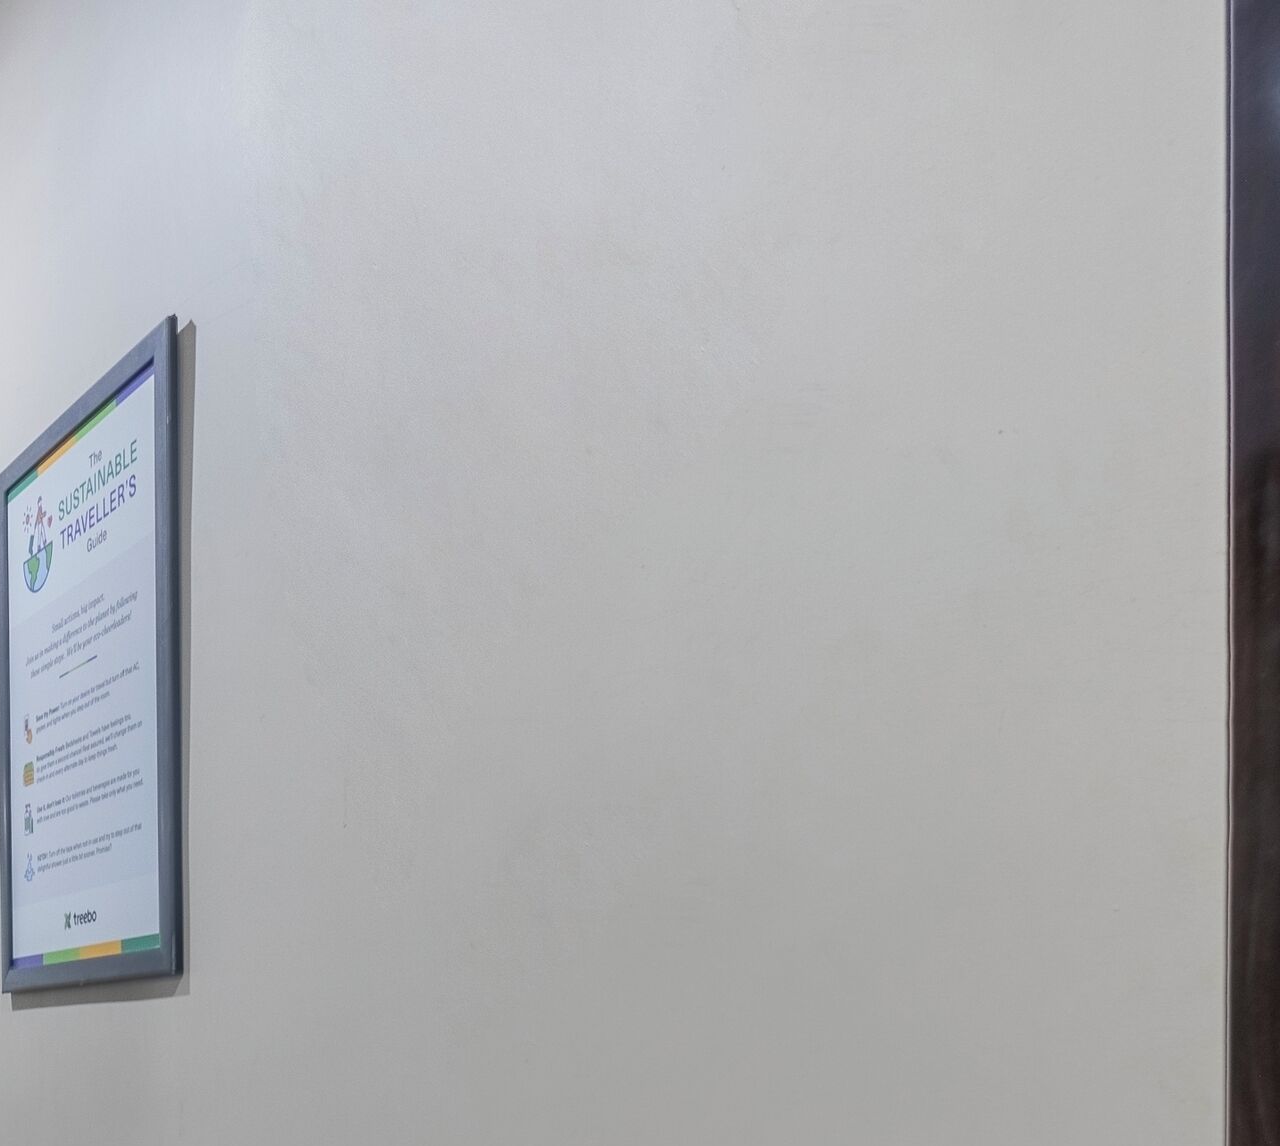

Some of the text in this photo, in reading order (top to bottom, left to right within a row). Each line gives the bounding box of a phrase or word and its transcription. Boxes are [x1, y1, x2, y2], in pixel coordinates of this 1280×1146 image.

[89, 449, 102, 468] The
[58, 440, 137, 521] SUSTAINABLE
[60, 474, 136, 549] TRAVELLER'S
[86, 529, 107, 552] Guide
[62, 625, 81, 643] difference
[115, 591, 137, 611] following
[73, 909, 97, 926] treebo
